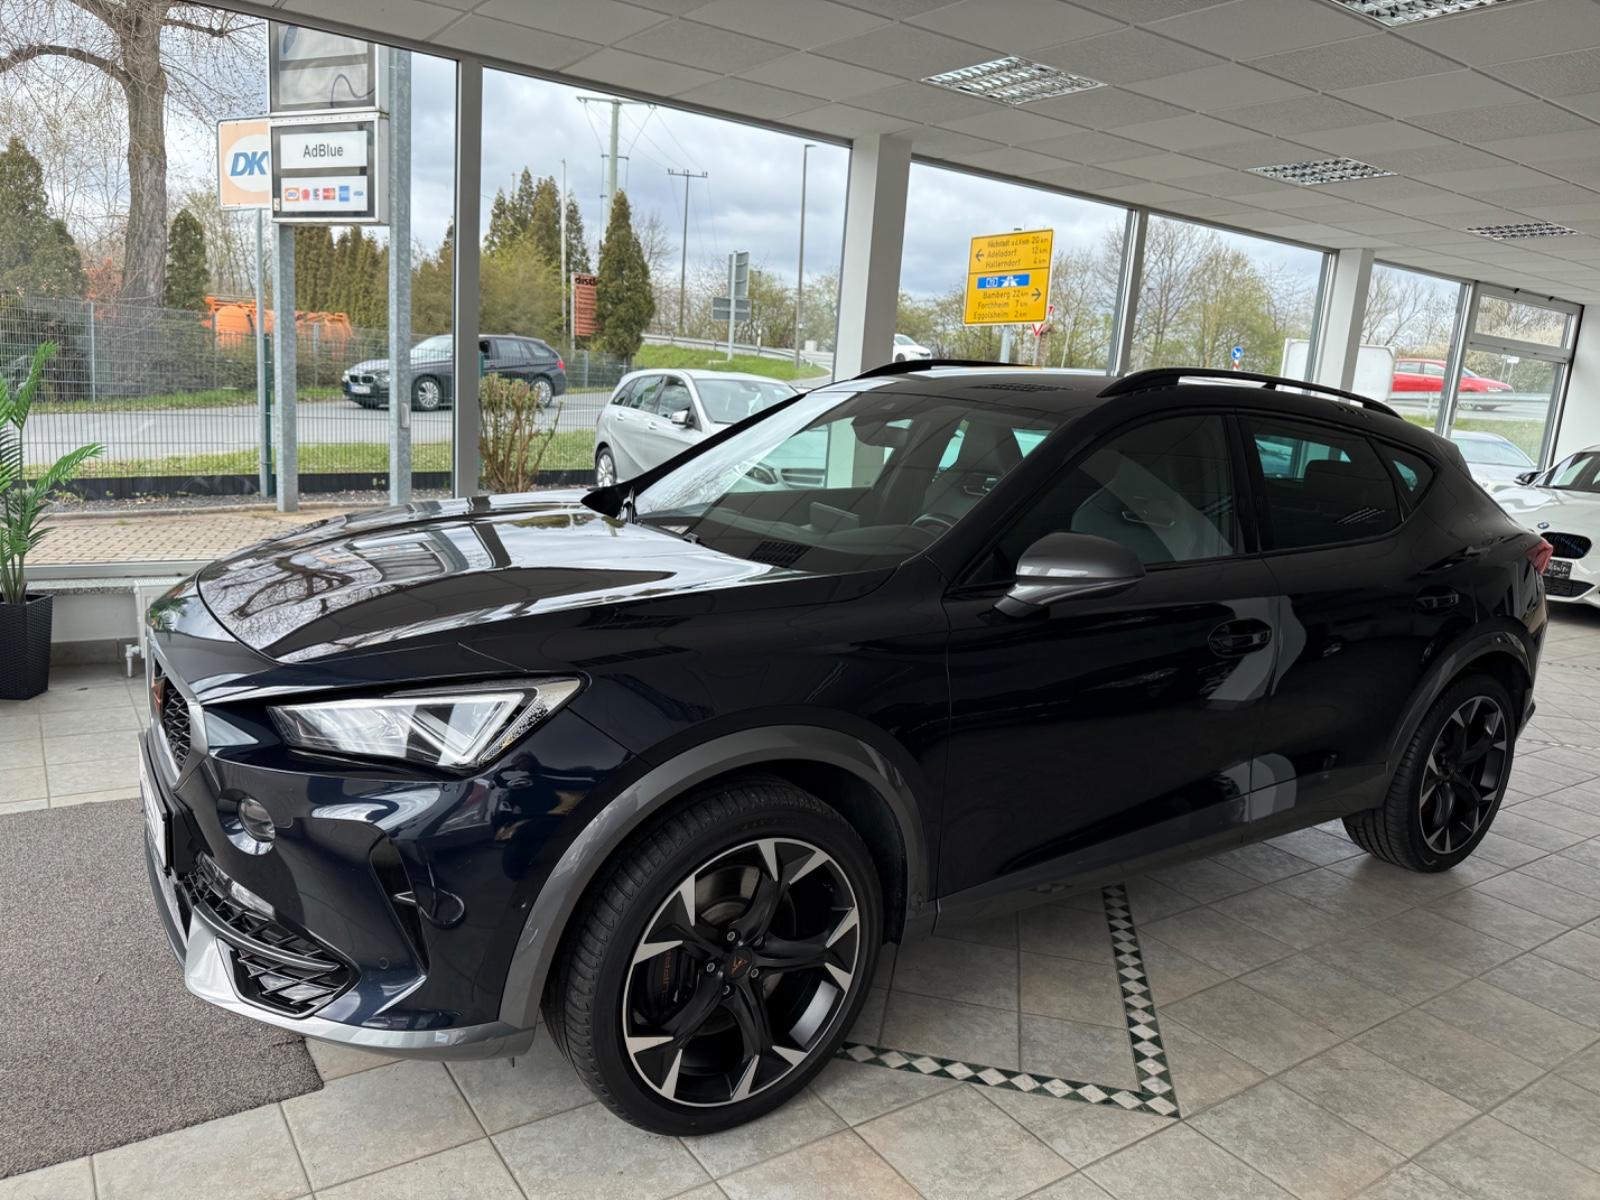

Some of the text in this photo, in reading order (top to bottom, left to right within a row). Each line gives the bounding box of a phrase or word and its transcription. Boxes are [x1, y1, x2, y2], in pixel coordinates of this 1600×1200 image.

[303, 144, 344, 158] AdBlue
[985, 258, 1021, 269] Hallerndorf
[1012, 289, 1021, 298] 22
